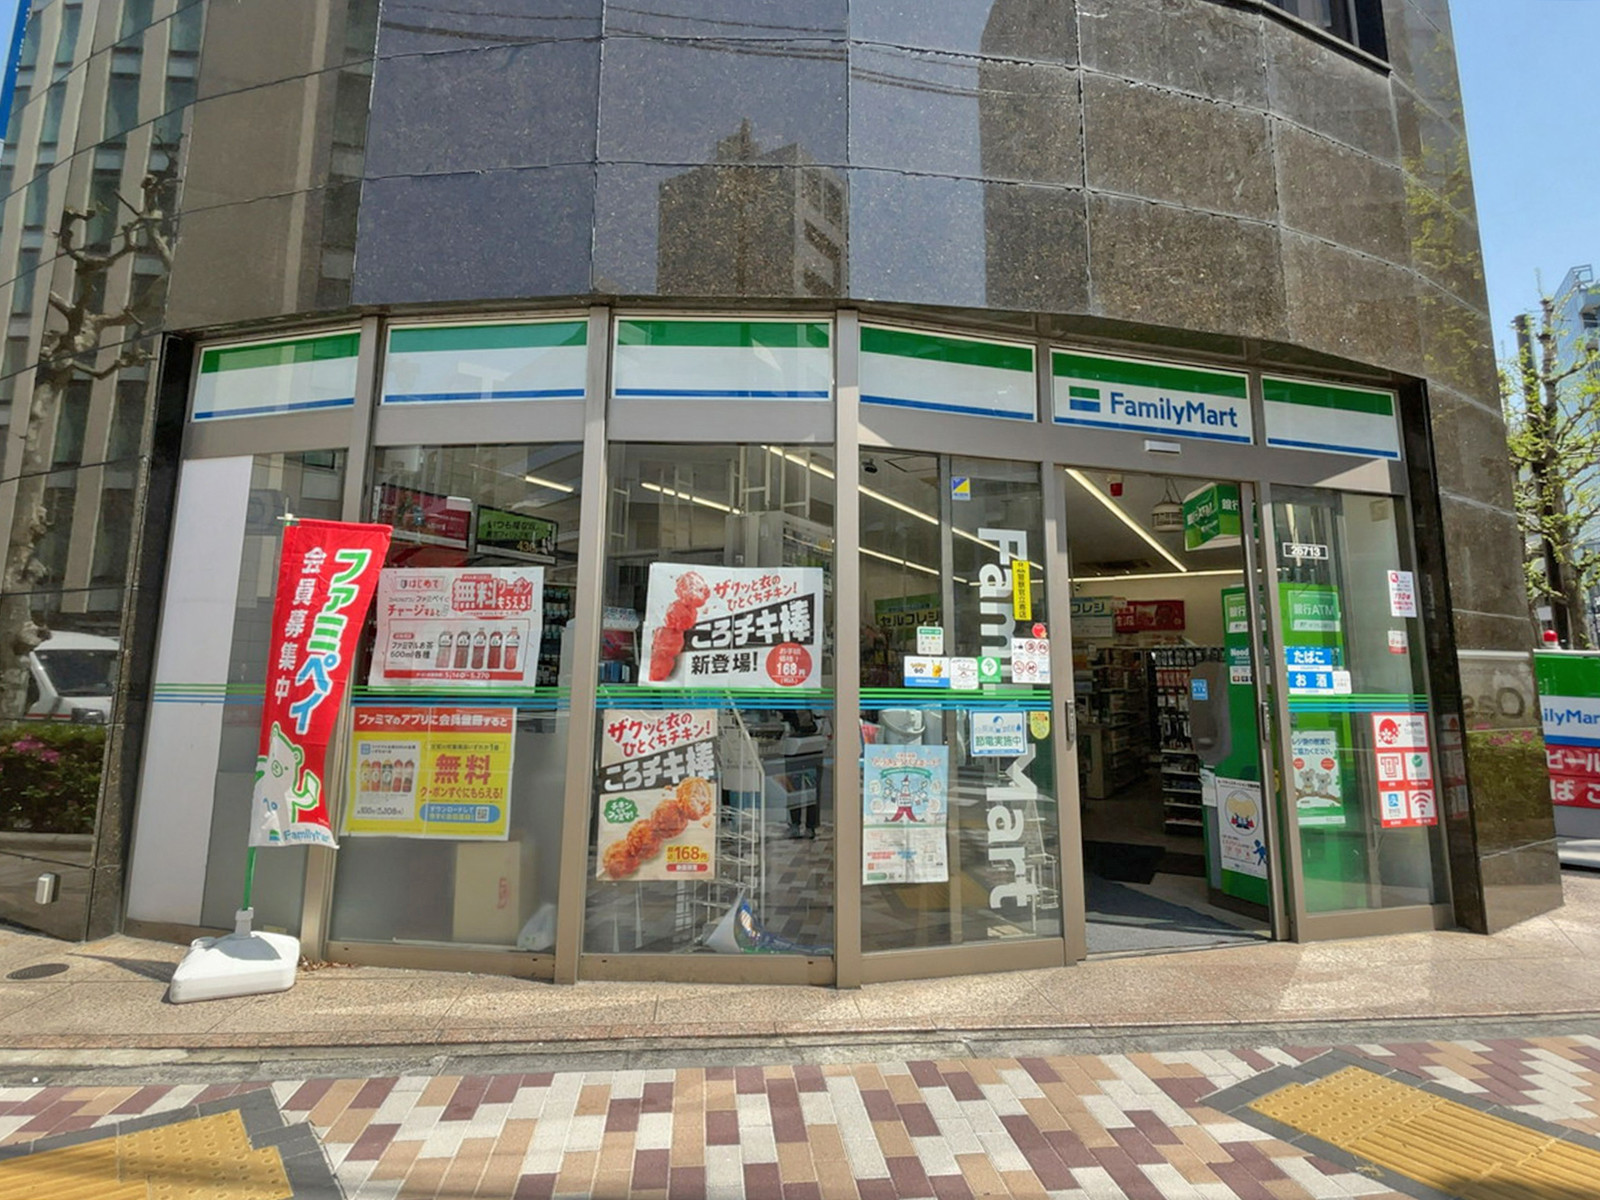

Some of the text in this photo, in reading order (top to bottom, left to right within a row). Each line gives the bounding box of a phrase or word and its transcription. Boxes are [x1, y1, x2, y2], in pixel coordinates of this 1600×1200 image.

[1110, 391, 1238, 427] FamilyMart
[453, 580, 497, 609] 無料
[498, 576, 533, 596] クーポン
[714, 574, 781, 600] ザクッと衣の
[727, 582, 798, 612] ひとくちチキン!
[691, 599, 811, 649] ころチキ棒
[1293, 603, 1335, 617] 銀行ATM
[275, 546, 328, 705] 会員募集中
[289, 548, 373, 735] ファミペイ
[691, 651, 758, 676] 新登場!
[1293, 650, 1326, 664] たばこ
[607, 712, 693, 743] ザクッと衣の
[1541, 708, 1600, 726] ilyMar
[622, 720, 711, 757] ひとくちチキン!
[434, 753, 491, 785] 無料
[604, 741, 715, 792] ころチキ棒
[420, 786, 503, 800] クーポンすぐにもらえる!
